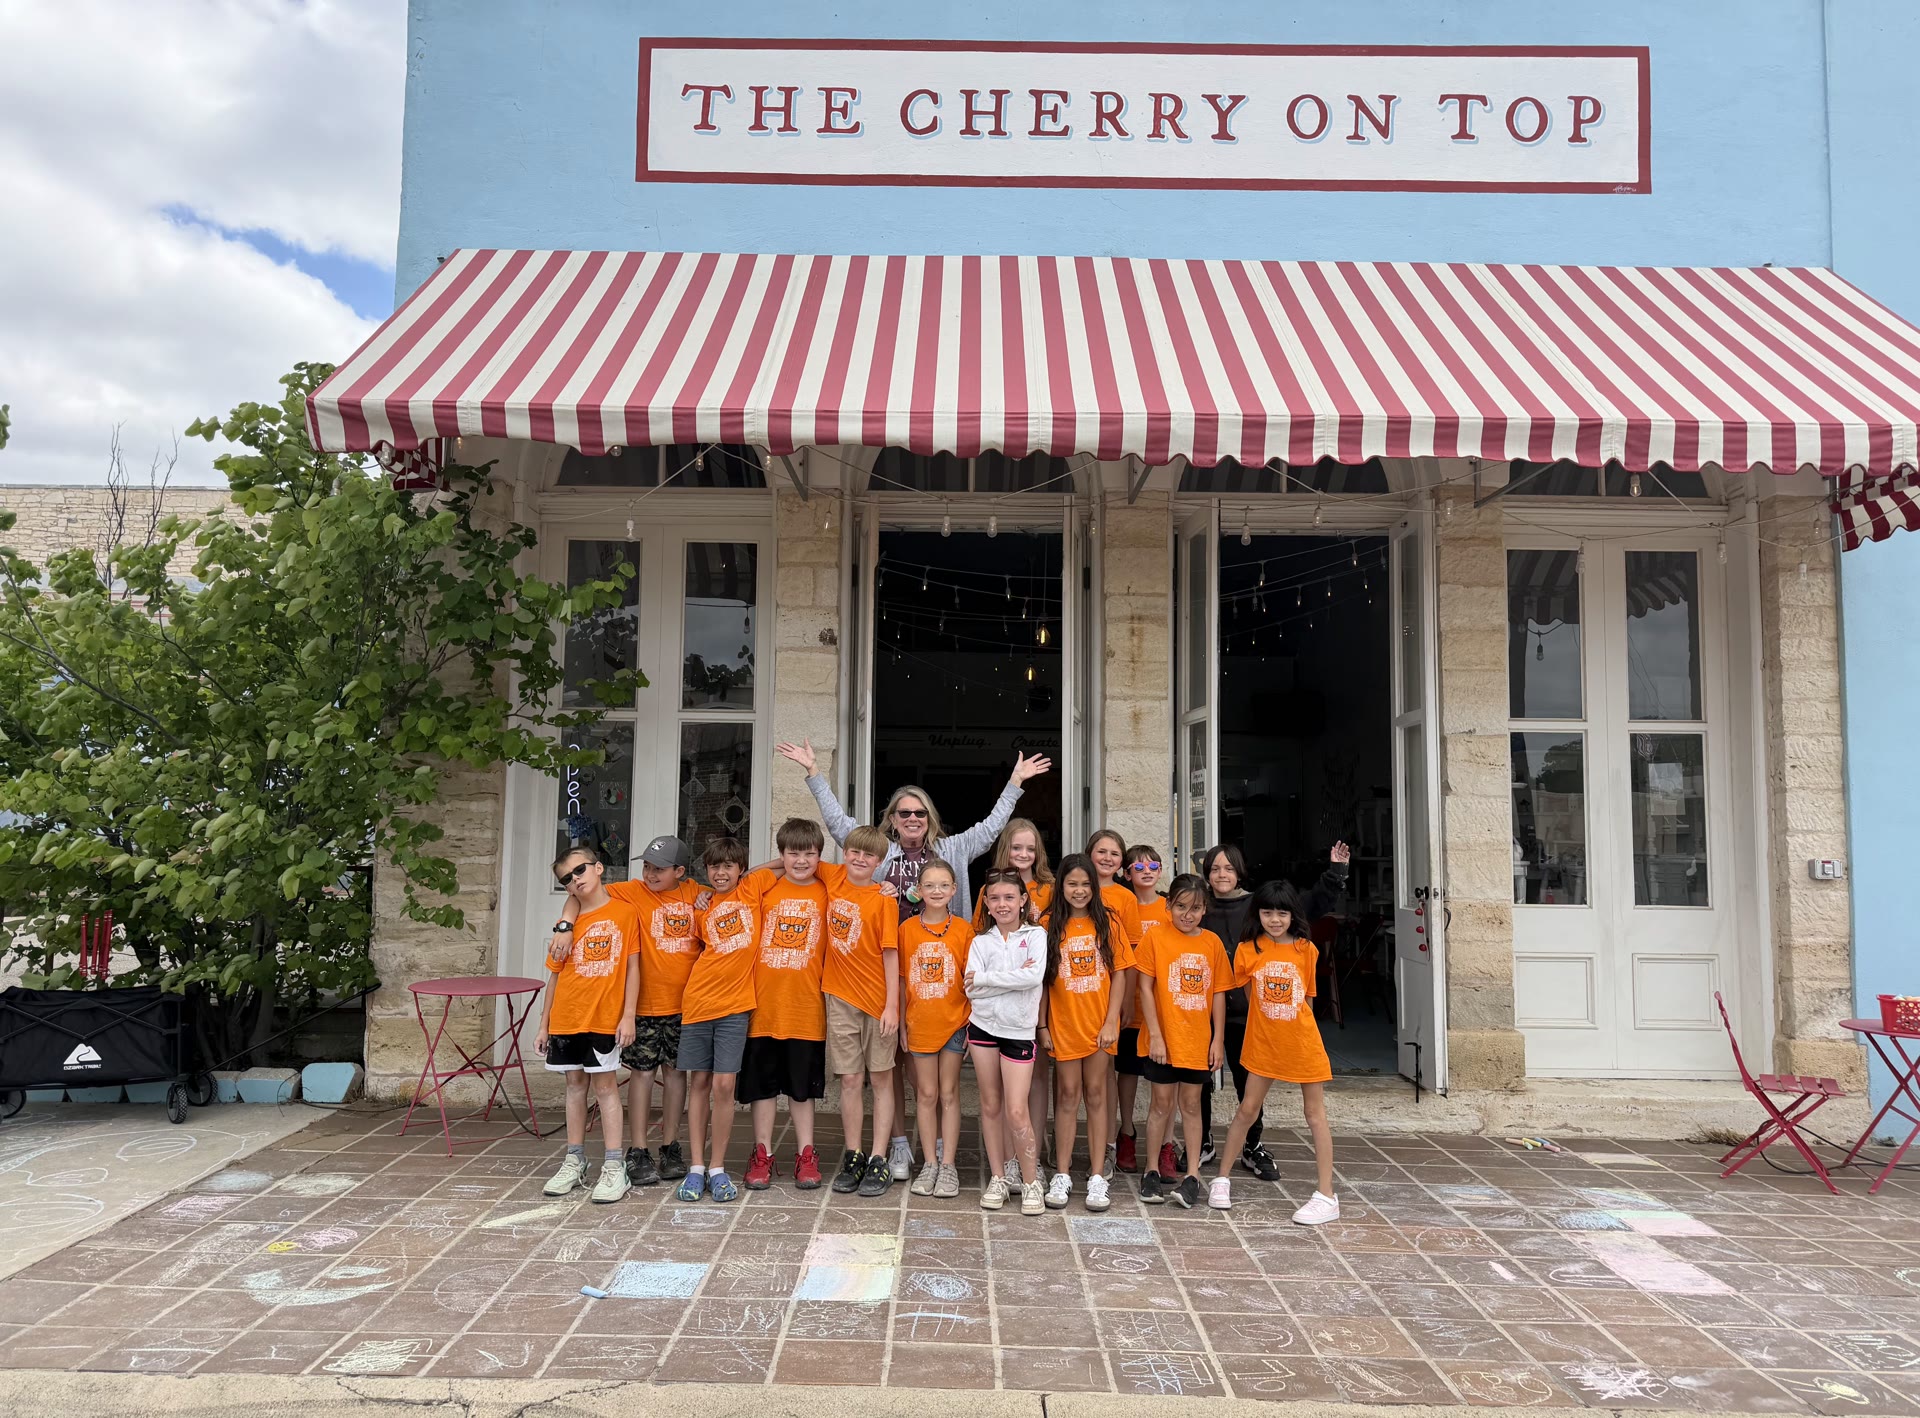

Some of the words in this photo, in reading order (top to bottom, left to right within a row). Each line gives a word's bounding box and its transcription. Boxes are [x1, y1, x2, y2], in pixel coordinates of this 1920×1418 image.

[681, 83, 863, 137] THE
[899, 88, 1248, 144] CHERRY
[1286, 93, 1401, 144] ON
[1438, 93, 1605, 147] TOP
[1011, 735, 1061, 749] Create
